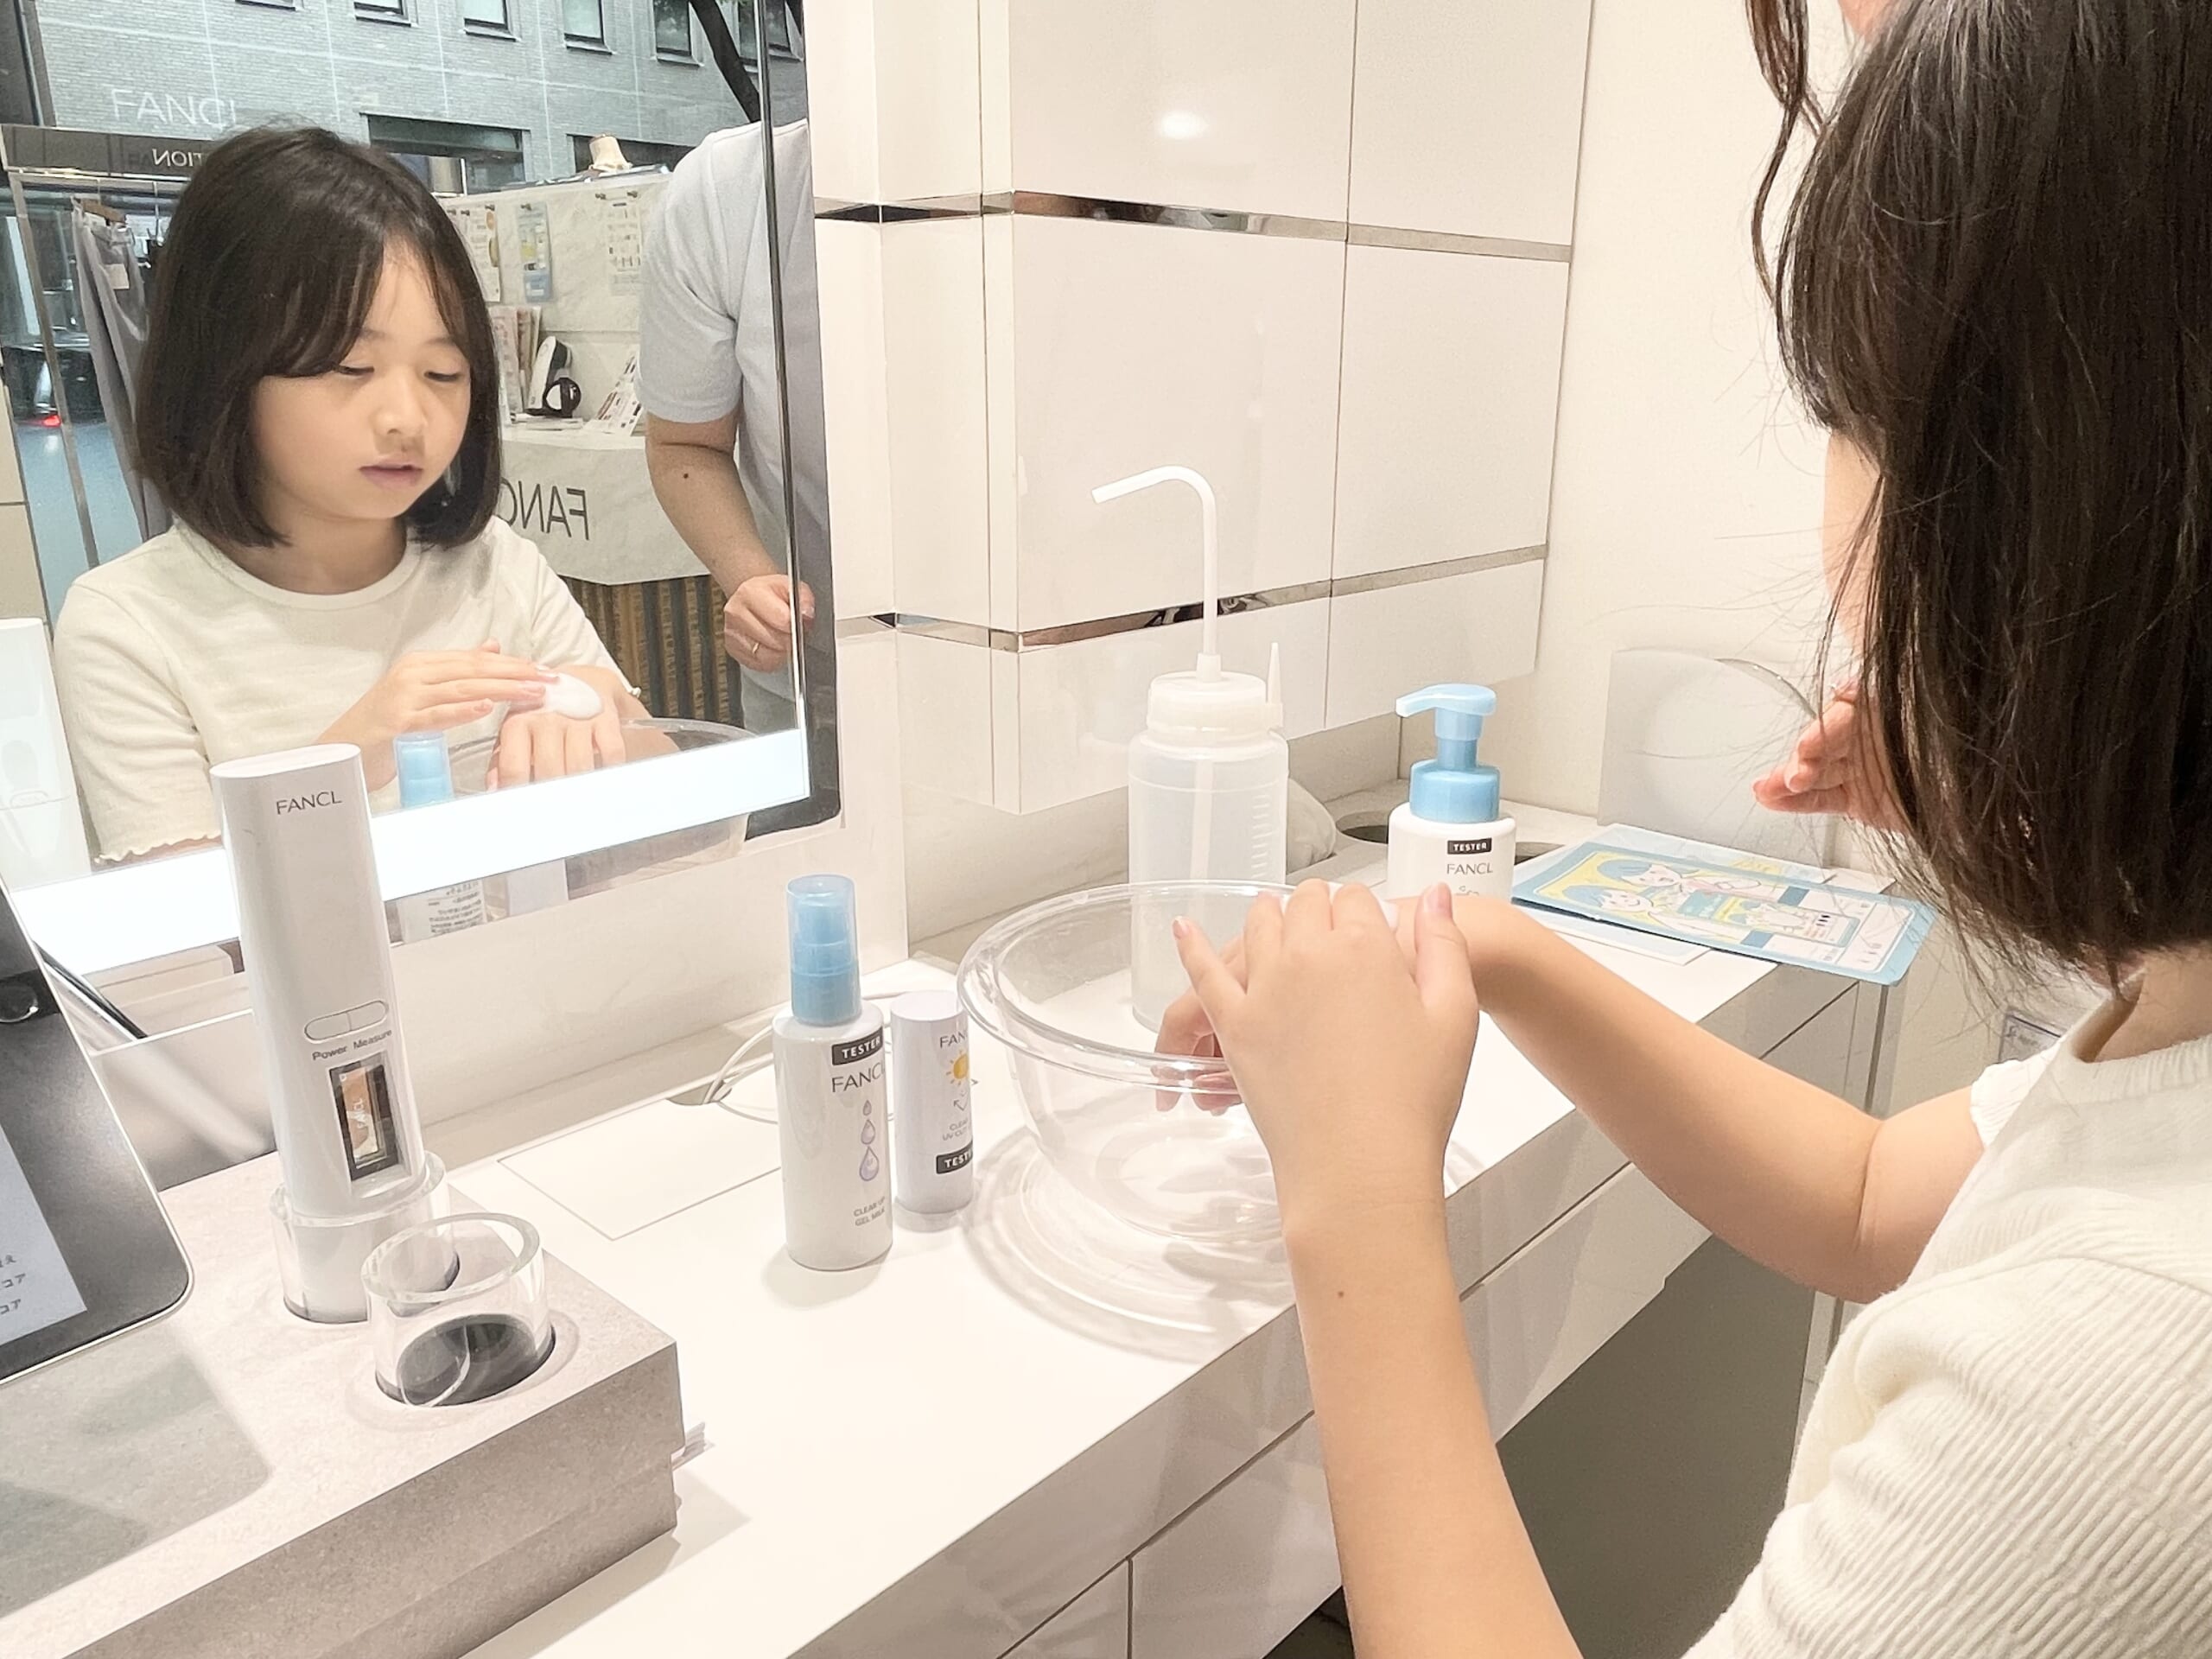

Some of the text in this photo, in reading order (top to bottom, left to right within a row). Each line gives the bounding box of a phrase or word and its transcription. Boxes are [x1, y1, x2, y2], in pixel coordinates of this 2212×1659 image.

[276, 791, 343, 815] FANCL
[1452, 842, 1488, 852] TESTER
[1446, 862, 1494, 874] FANCL
[312, 1030, 392, 1061] Power Measure
[842, 1035, 881, 1059] TESTER
[0, 1273, 26, 1289] コア
